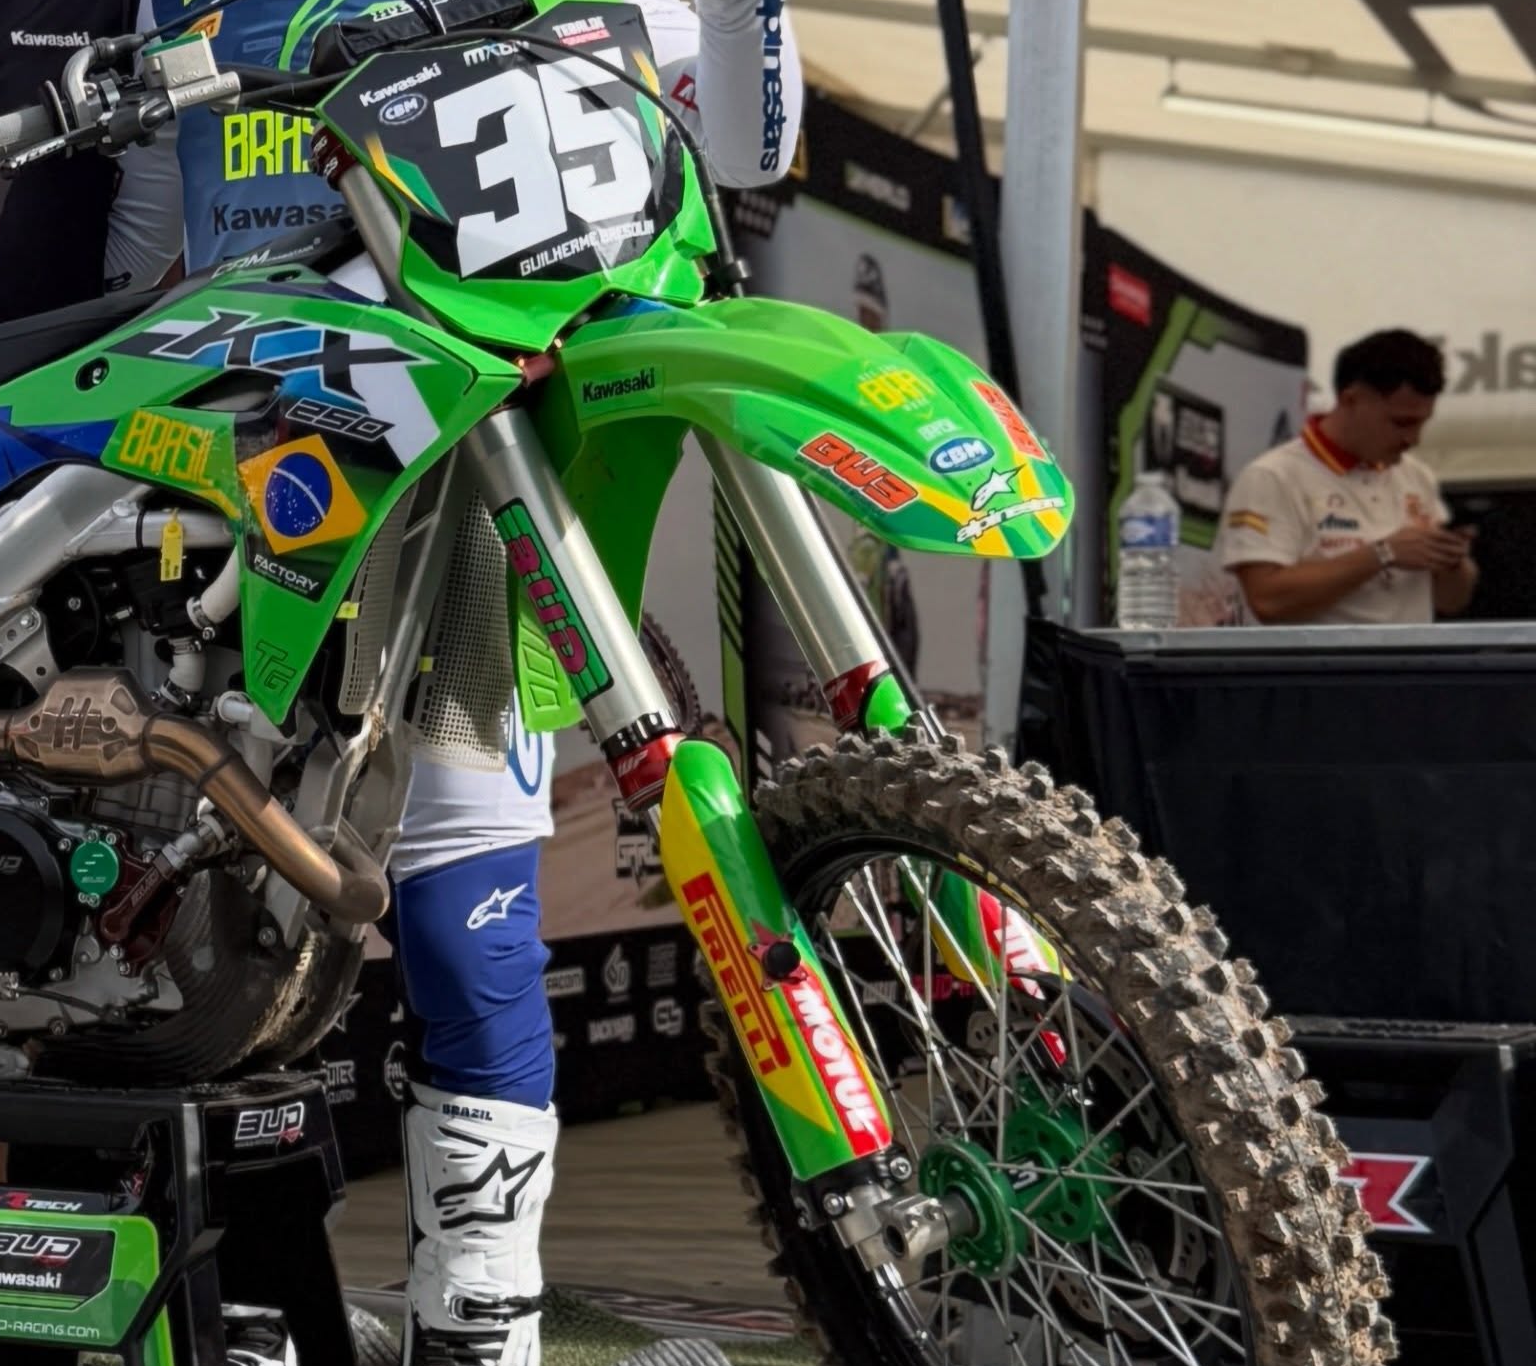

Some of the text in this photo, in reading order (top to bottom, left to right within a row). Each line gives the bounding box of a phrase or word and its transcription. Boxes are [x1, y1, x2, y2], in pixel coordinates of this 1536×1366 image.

[11, 30, 90, 47] Kawasaki
[359, 62, 442, 106] Kawasaki
[384, 97, 418, 120] CBM
[433, 47, 652, 277] 35
[520, 230, 600, 276] GUILHERME
[583, 367, 655, 403] Kawasaki
[285, 397, 395, 441] 250
[119, 410, 214, 487] BRASIL
[934, 439, 989, 469] CBM
[253, 554, 319, 591] FACTORY
[681, 871, 792, 1075] PIRELLI
[792, 981, 880, 1132] MOTUL
[235, 1101, 305, 1140] BUD
[442, 1103, 493, 1121] BRAZIL
